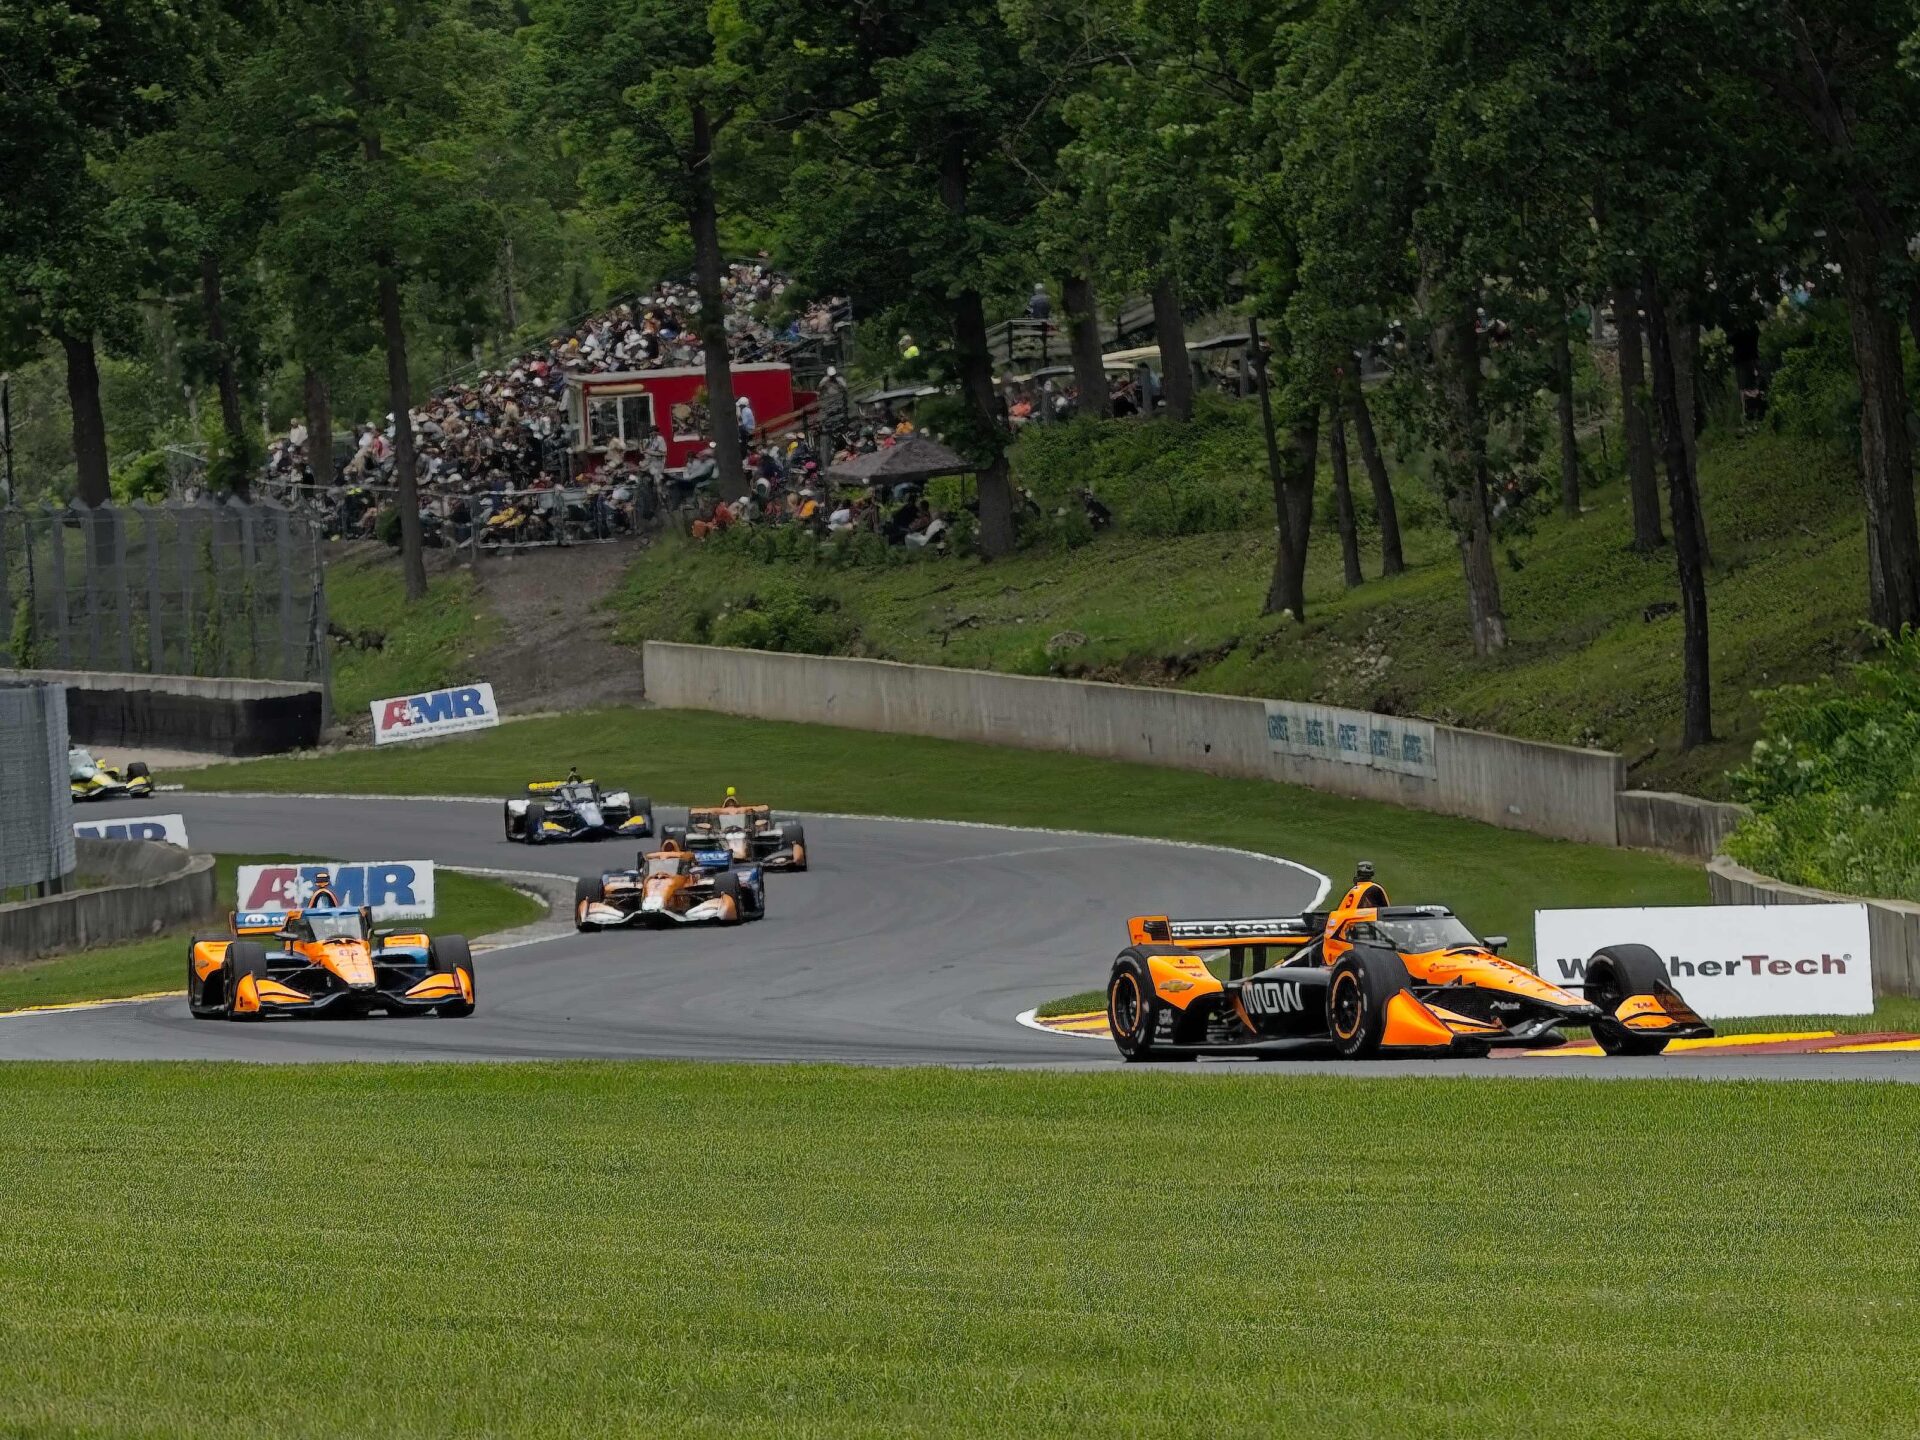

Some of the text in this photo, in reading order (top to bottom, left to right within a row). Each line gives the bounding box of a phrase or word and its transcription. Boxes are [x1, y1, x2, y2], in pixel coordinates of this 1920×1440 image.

[382, 688, 485, 730] AMR
[246, 864, 416, 909] AMR
[1557, 953, 1847, 979] WherTech
